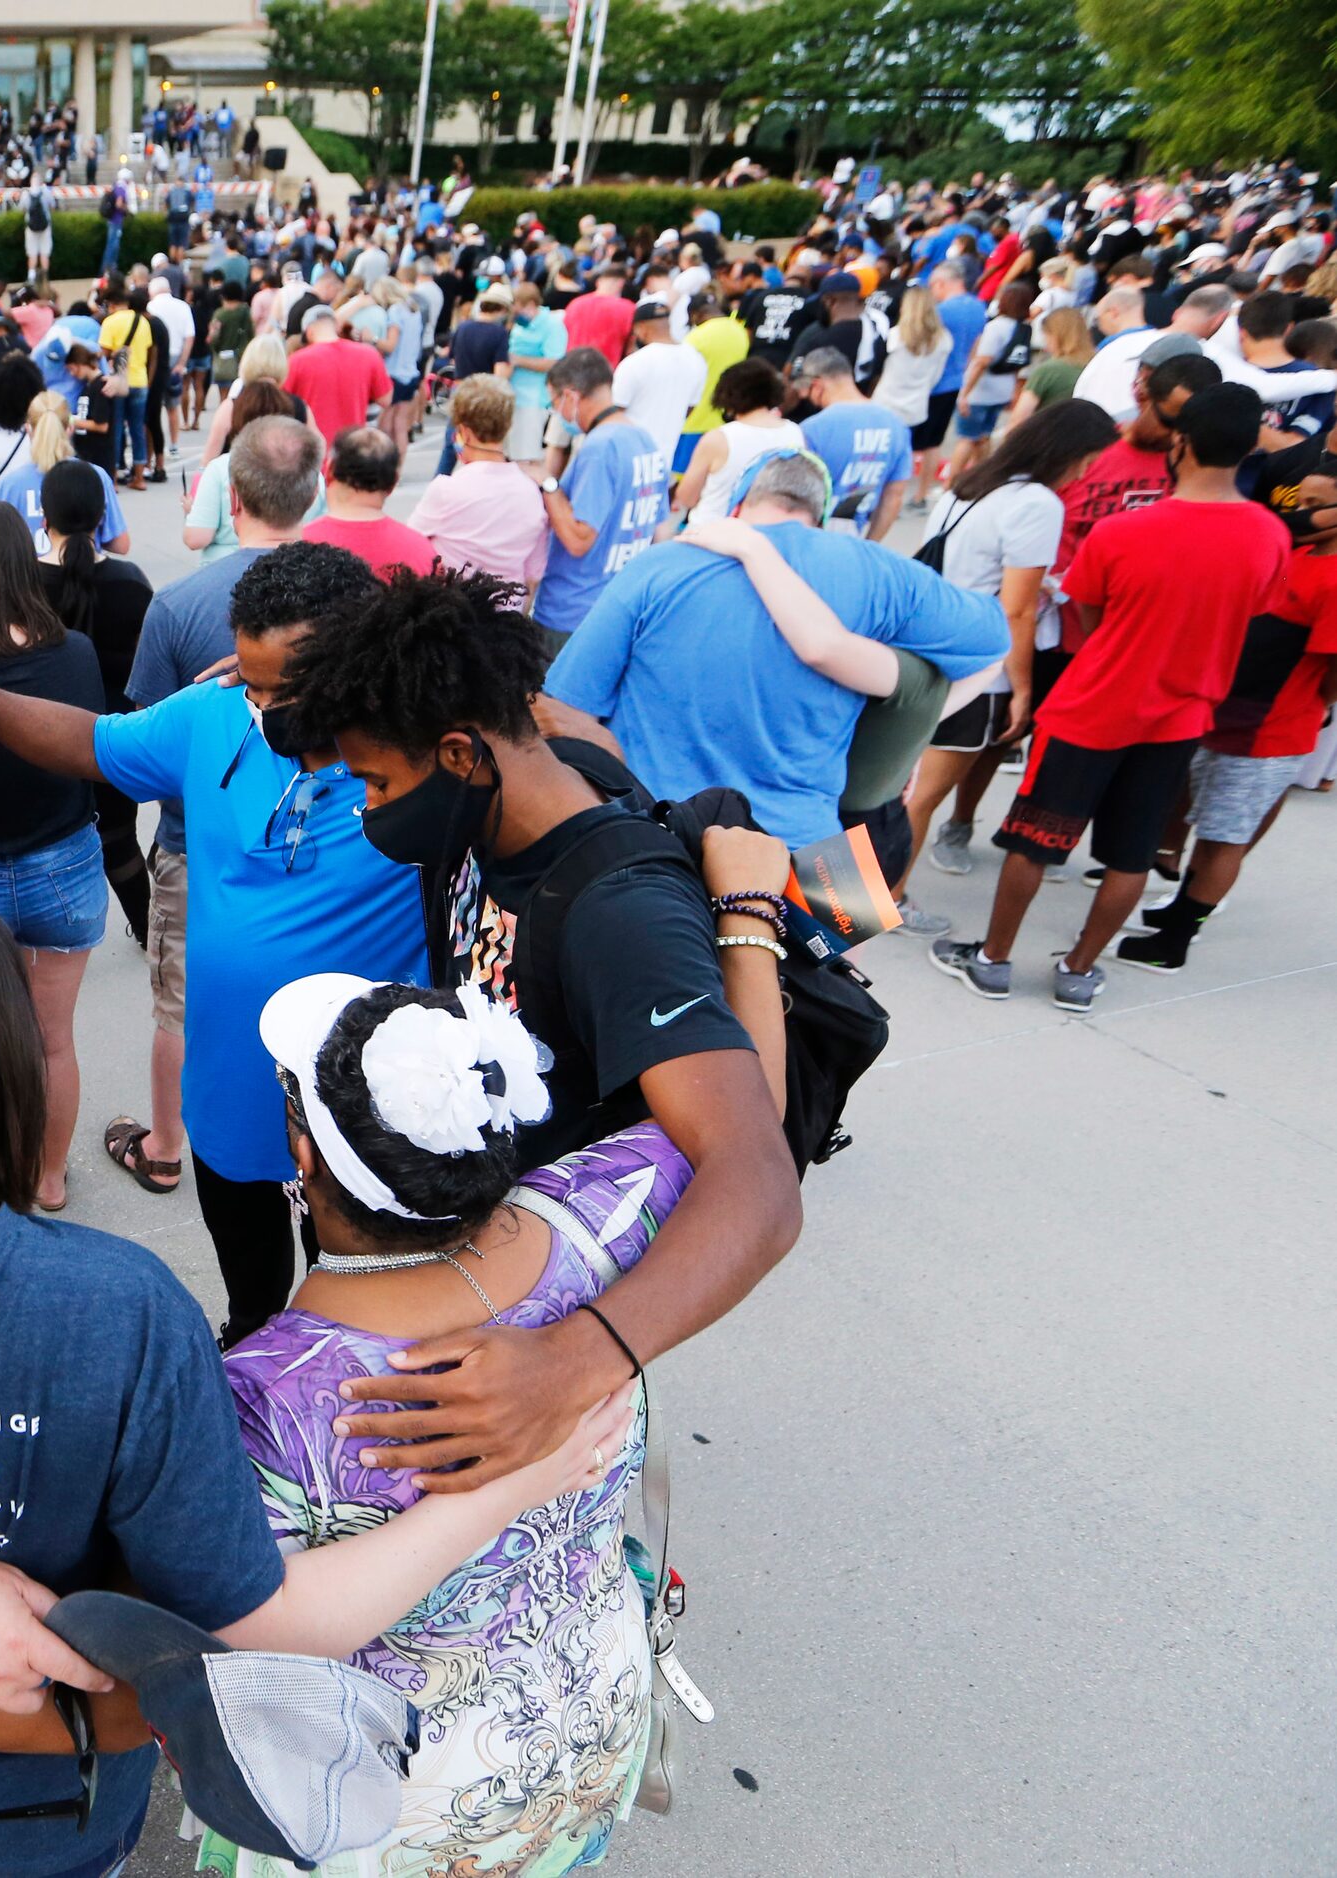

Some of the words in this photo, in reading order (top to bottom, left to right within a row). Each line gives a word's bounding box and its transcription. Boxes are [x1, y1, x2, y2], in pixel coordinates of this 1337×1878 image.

[853, 428, 891, 454] LIVE
[631, 452, 665, 487] LIVE
[814, 855, 832, 887] MEDIA
[825, 887, 854, 934] rightnow
